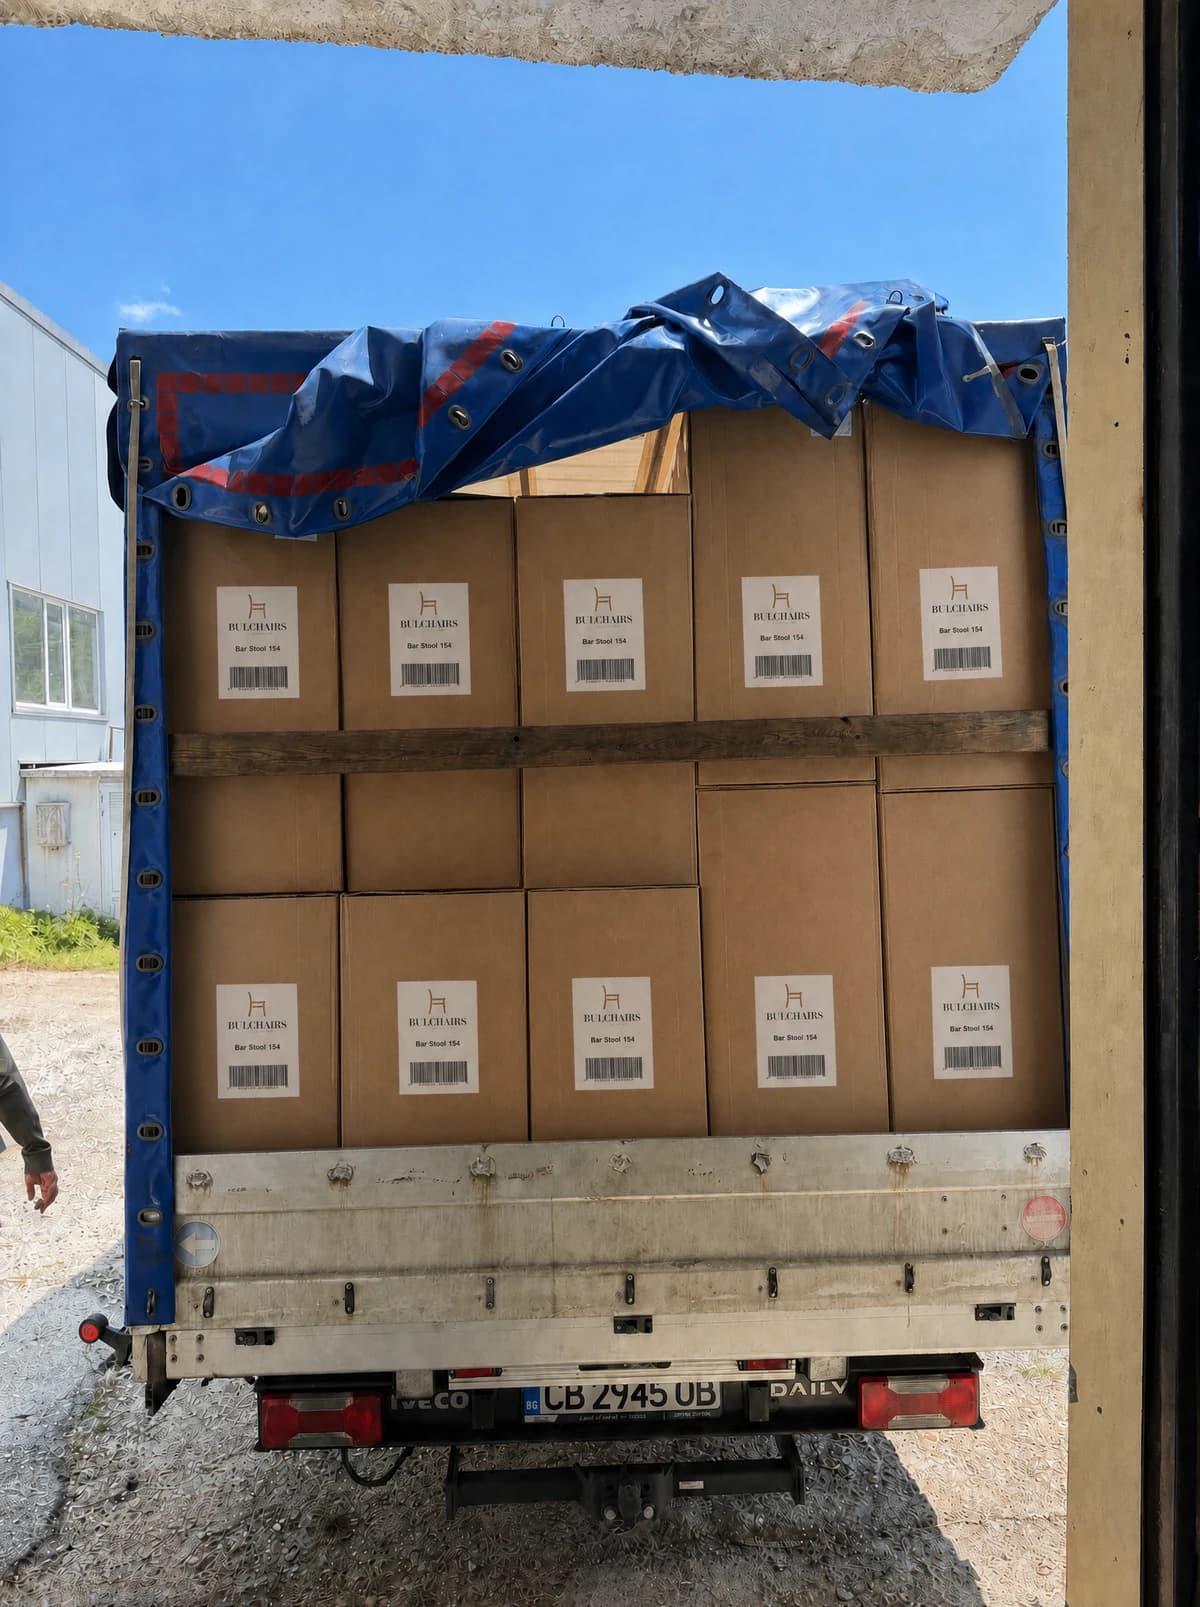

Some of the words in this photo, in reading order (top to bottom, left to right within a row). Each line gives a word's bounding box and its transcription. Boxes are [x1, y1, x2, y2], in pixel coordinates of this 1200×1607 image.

[931, 603, 989, 614] BULCHAIRS
[575, 615, 633, 625] BULCHAIRS
[753, 611, 811, 621] BULCHAIRS
[228, 622, 288, 632] BULCHAIRS
[400, 619, 459, 629] BULCHAIRS
[938, 627, 952, 635] Bar
[951, 626, 970, 634] Stool
[970, 625, 983, 633] 154
[581, 638, 595, 646] Bar
[595, 637, 613, 645] Stool
[615, 637, 627, 645] 154
[759, 634, 772, 642] Bar
[792, 633, 805, 641] 154
[234, 645, 248, 653] Bar
[406, 642, 419, 650] Bar
[439, 641, 452, 649] 154
[943, 1001, 1000, 1012] BULCHAIRS
[583, 1013, 641, 1023] BULCHAIRS
[766, 1011, 824, 1021] BULCHAIRS
[228, 1020, 288, 1030] BULCHAIRS
[409, 1017, 467, 1027] BULCHAIRS
[949, 1025, 962, 1033] Bar
[962, 1025, 981, 1033] Stool
[981, 1024, 994, 1032] 154
[590, 1036, 603, 1044] Bar
[603, 1036, 622, 1044] Stool
[623, 1035, 636, 1043] 154
[773, 1034, 786, 1042] Bar
[805, 1033, 818, 1041] 154
[234, 1043, 247, 1051] Bar
[248, 1043, 267, 1051] Stool
[268, 1043, 281, 1051] 154
[415, 1040, 428, 1048] Bar
[428, 1040, 447, 1048] Stool
[448, 1039, 461, 1047] 154
[544, 1384, 586, 1411] CB
[592, 1383, 669, 1410] 2945
[526, 1400, 538, 1410] BG
